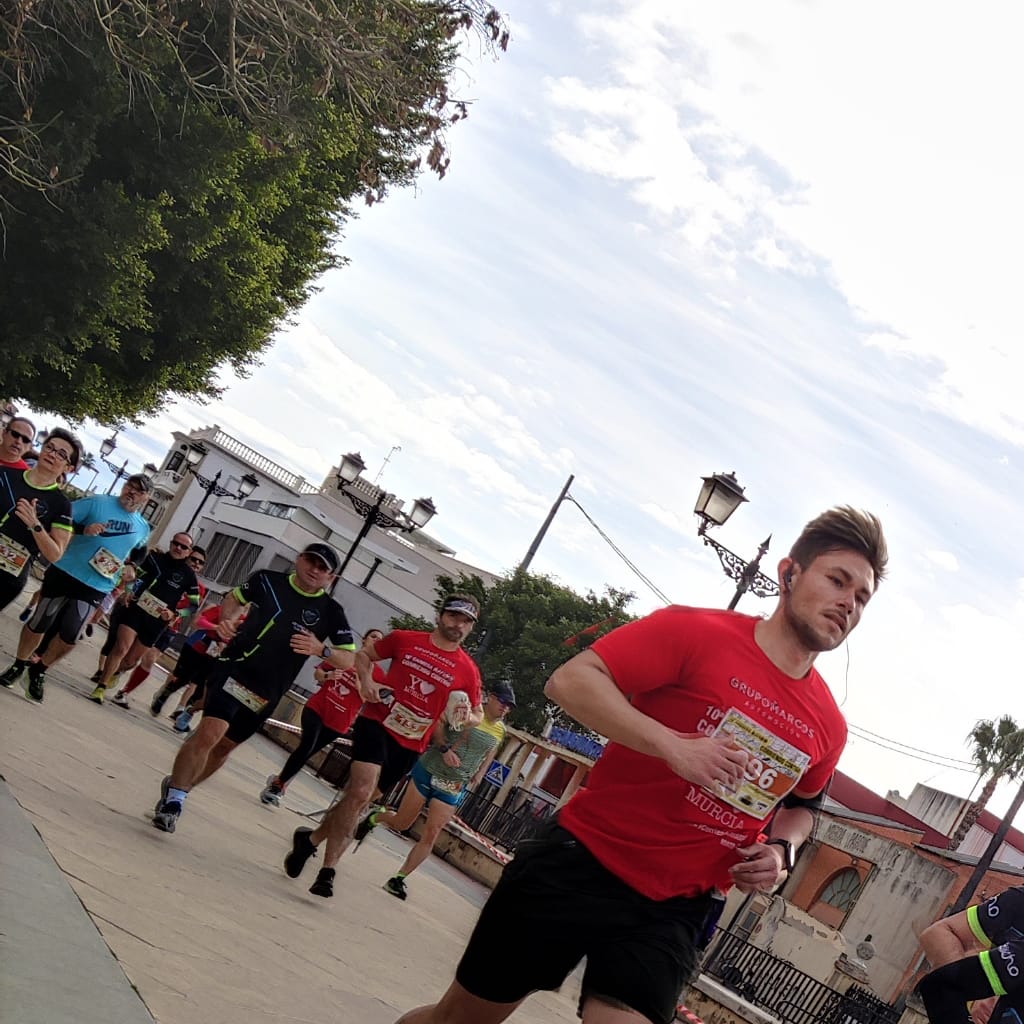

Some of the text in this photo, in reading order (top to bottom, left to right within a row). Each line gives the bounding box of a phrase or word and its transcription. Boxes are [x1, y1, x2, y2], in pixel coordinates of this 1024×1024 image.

[730, 677, 815, 739] GRUPOMARCOS
[744, 758, 778, 790] 96
[685, 785, 744, 829] MURCIA
